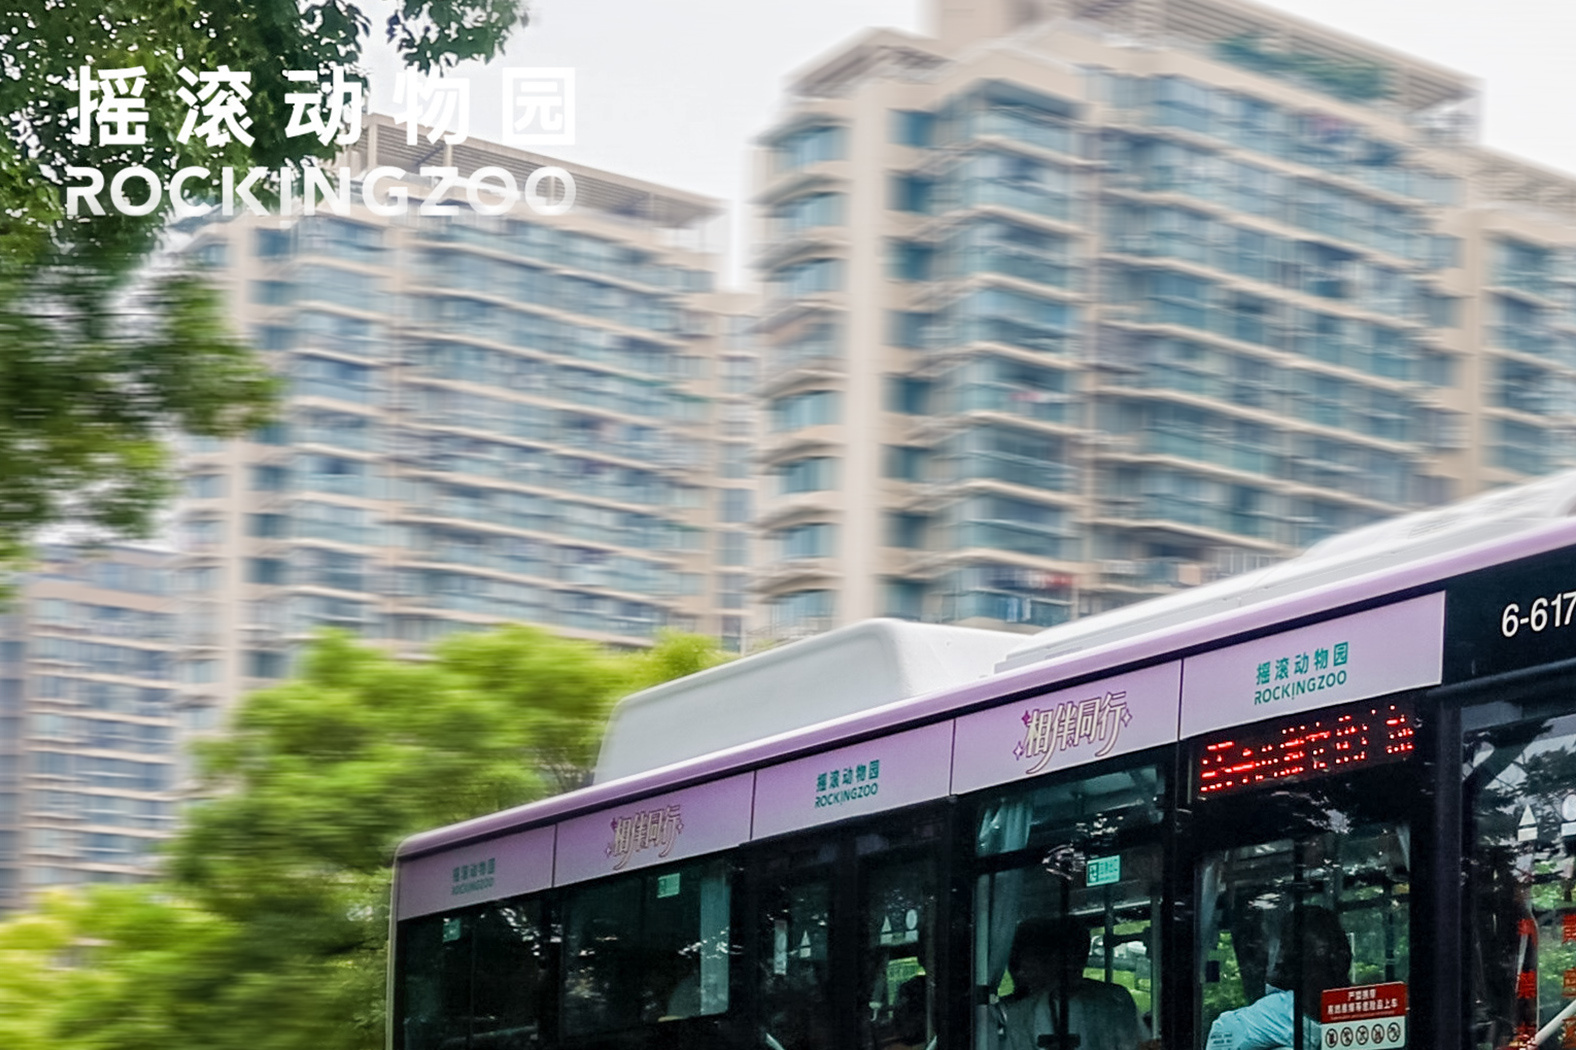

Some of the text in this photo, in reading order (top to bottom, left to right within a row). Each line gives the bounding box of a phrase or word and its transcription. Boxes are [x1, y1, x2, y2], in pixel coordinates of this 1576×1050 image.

[1256, 642, 1348, 685] 摇滚动物园
[1254, 670, 1347, 705] ROCKINGZOO
[1024, 691, 1127, 775] 相伴同行
[815, 783, 878, 808] ROCKINGZOO
